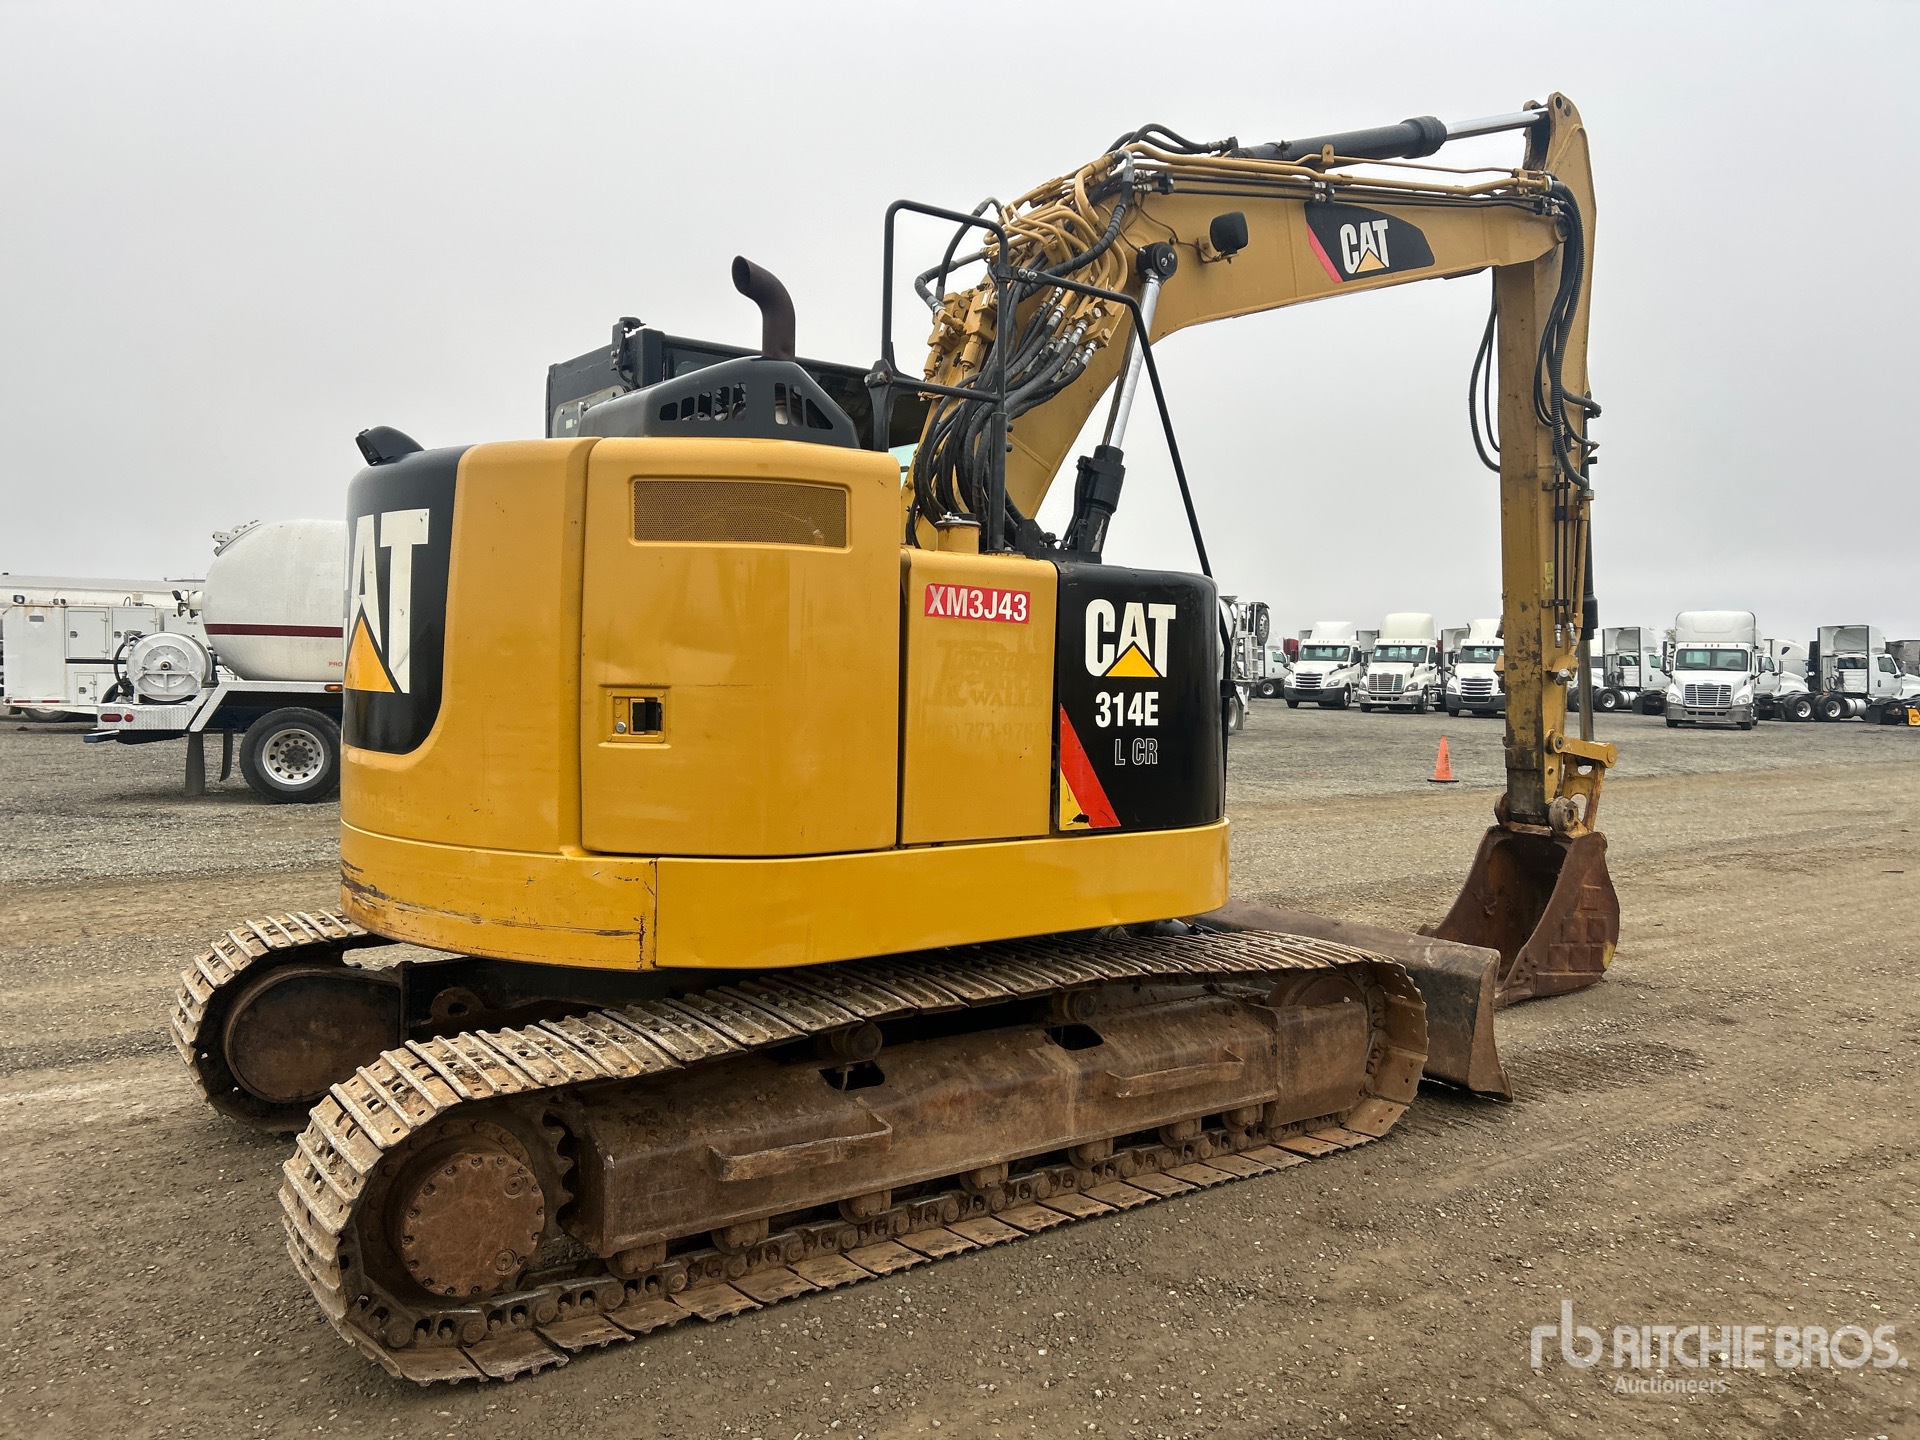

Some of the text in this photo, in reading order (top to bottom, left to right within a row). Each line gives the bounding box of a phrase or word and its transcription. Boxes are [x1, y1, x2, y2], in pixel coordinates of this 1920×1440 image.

[1340, 219, 1389, 273] CAT
[344, 508, 429, 693] AT
[927, 585, 1027, 621] XM3J43
[1085, 598, 1176, 677] CAT
[1095, 691, 1159, 727] 314E
[1114, 737, 1158, 765] L CR
